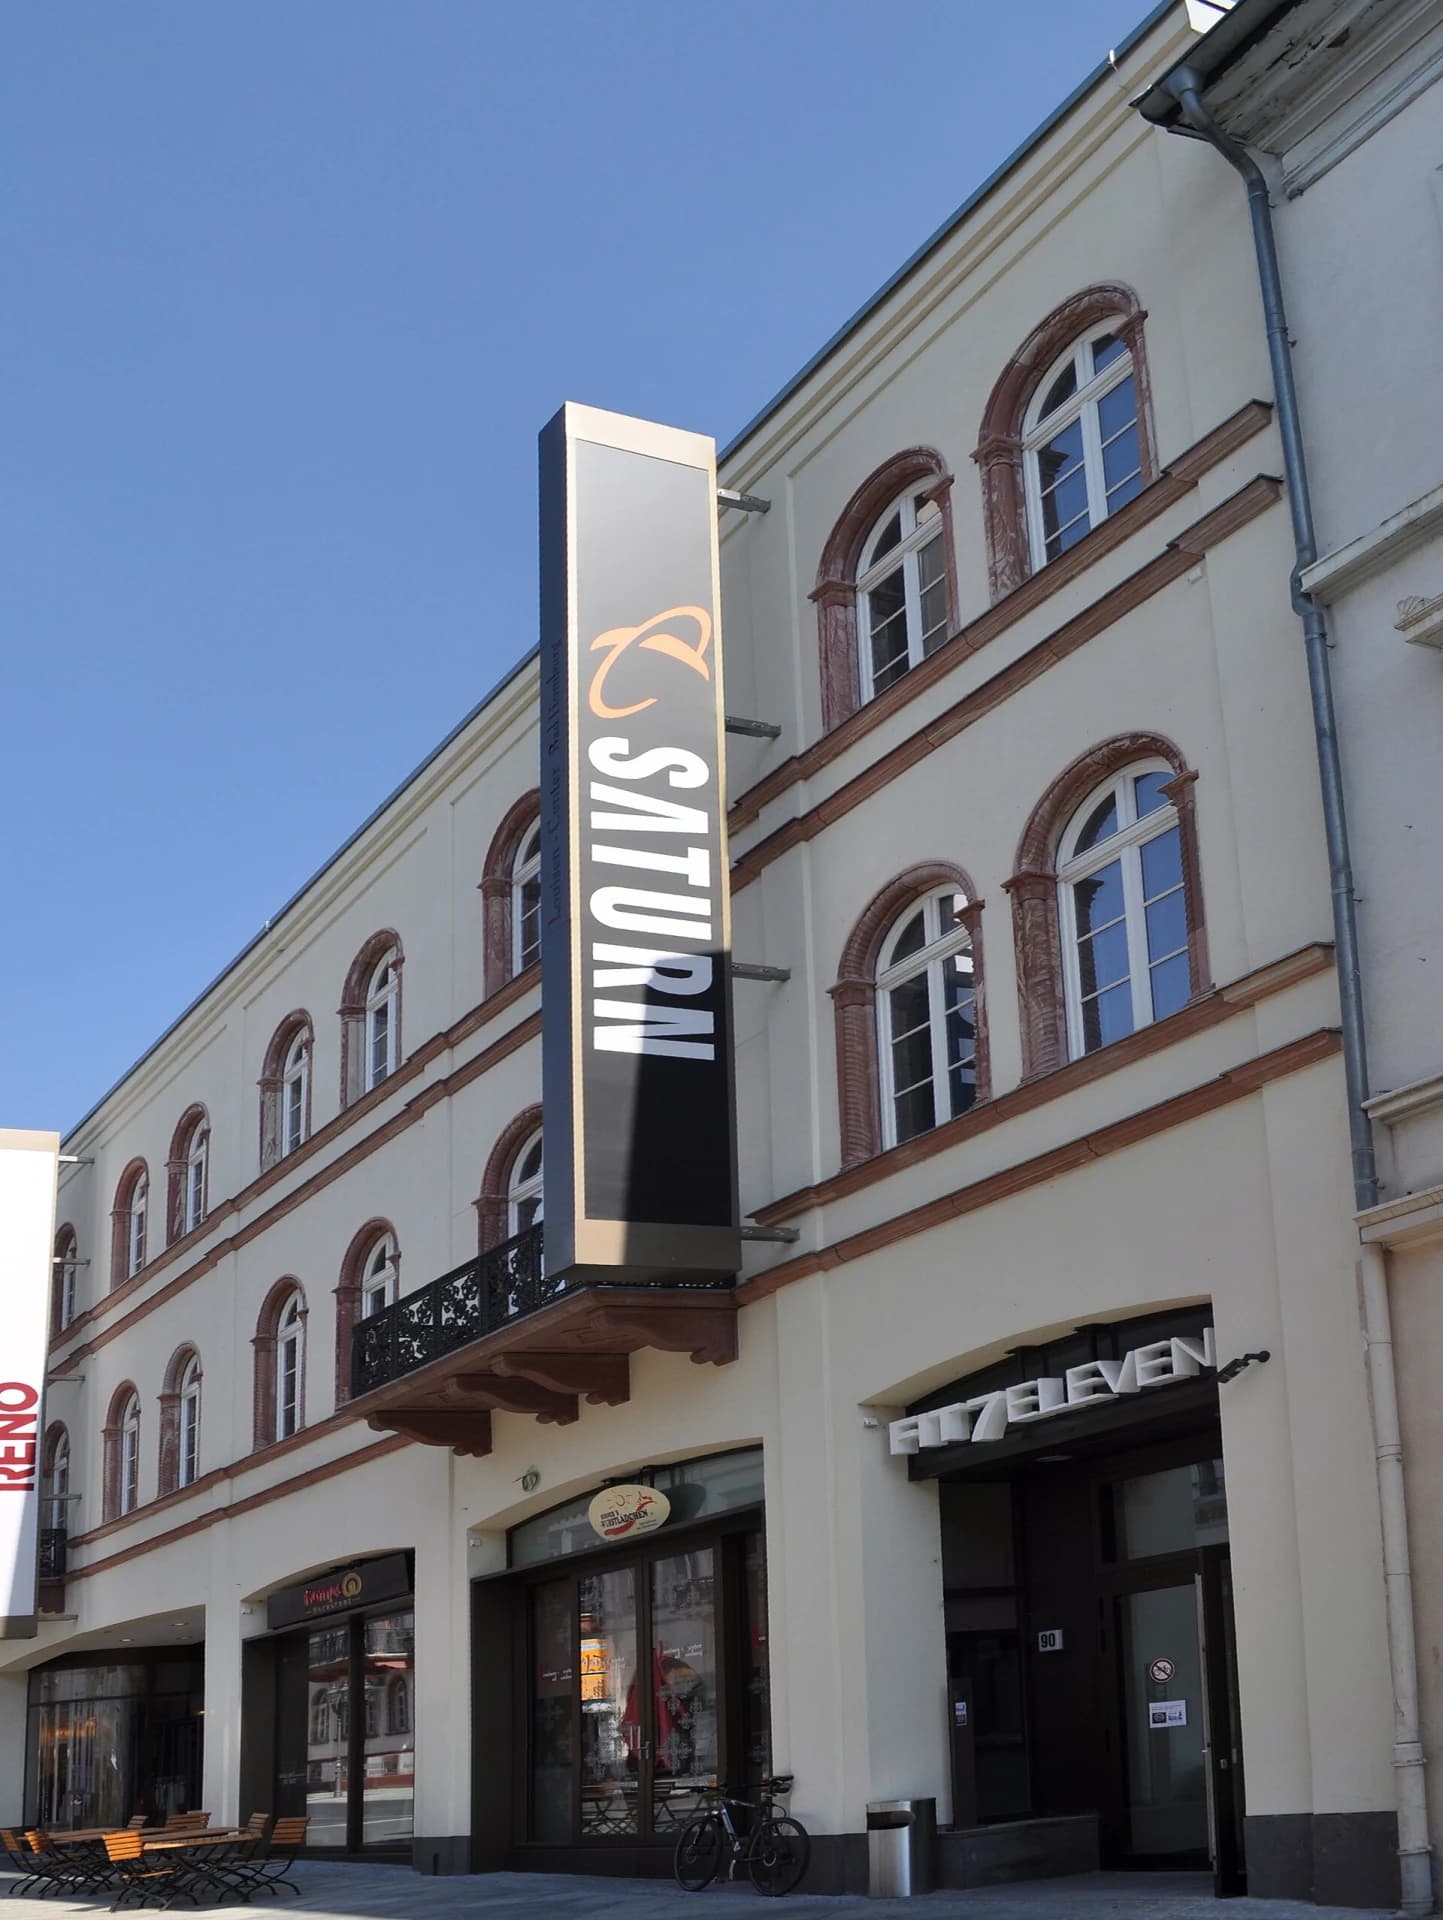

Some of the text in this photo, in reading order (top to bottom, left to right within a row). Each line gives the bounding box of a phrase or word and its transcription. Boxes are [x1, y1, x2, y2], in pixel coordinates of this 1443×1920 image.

[588, 736, 715, 1061] SATURN
[0, 1382, 39, 1491] RENO
[1040, 1632, 1056, 1649] 90
